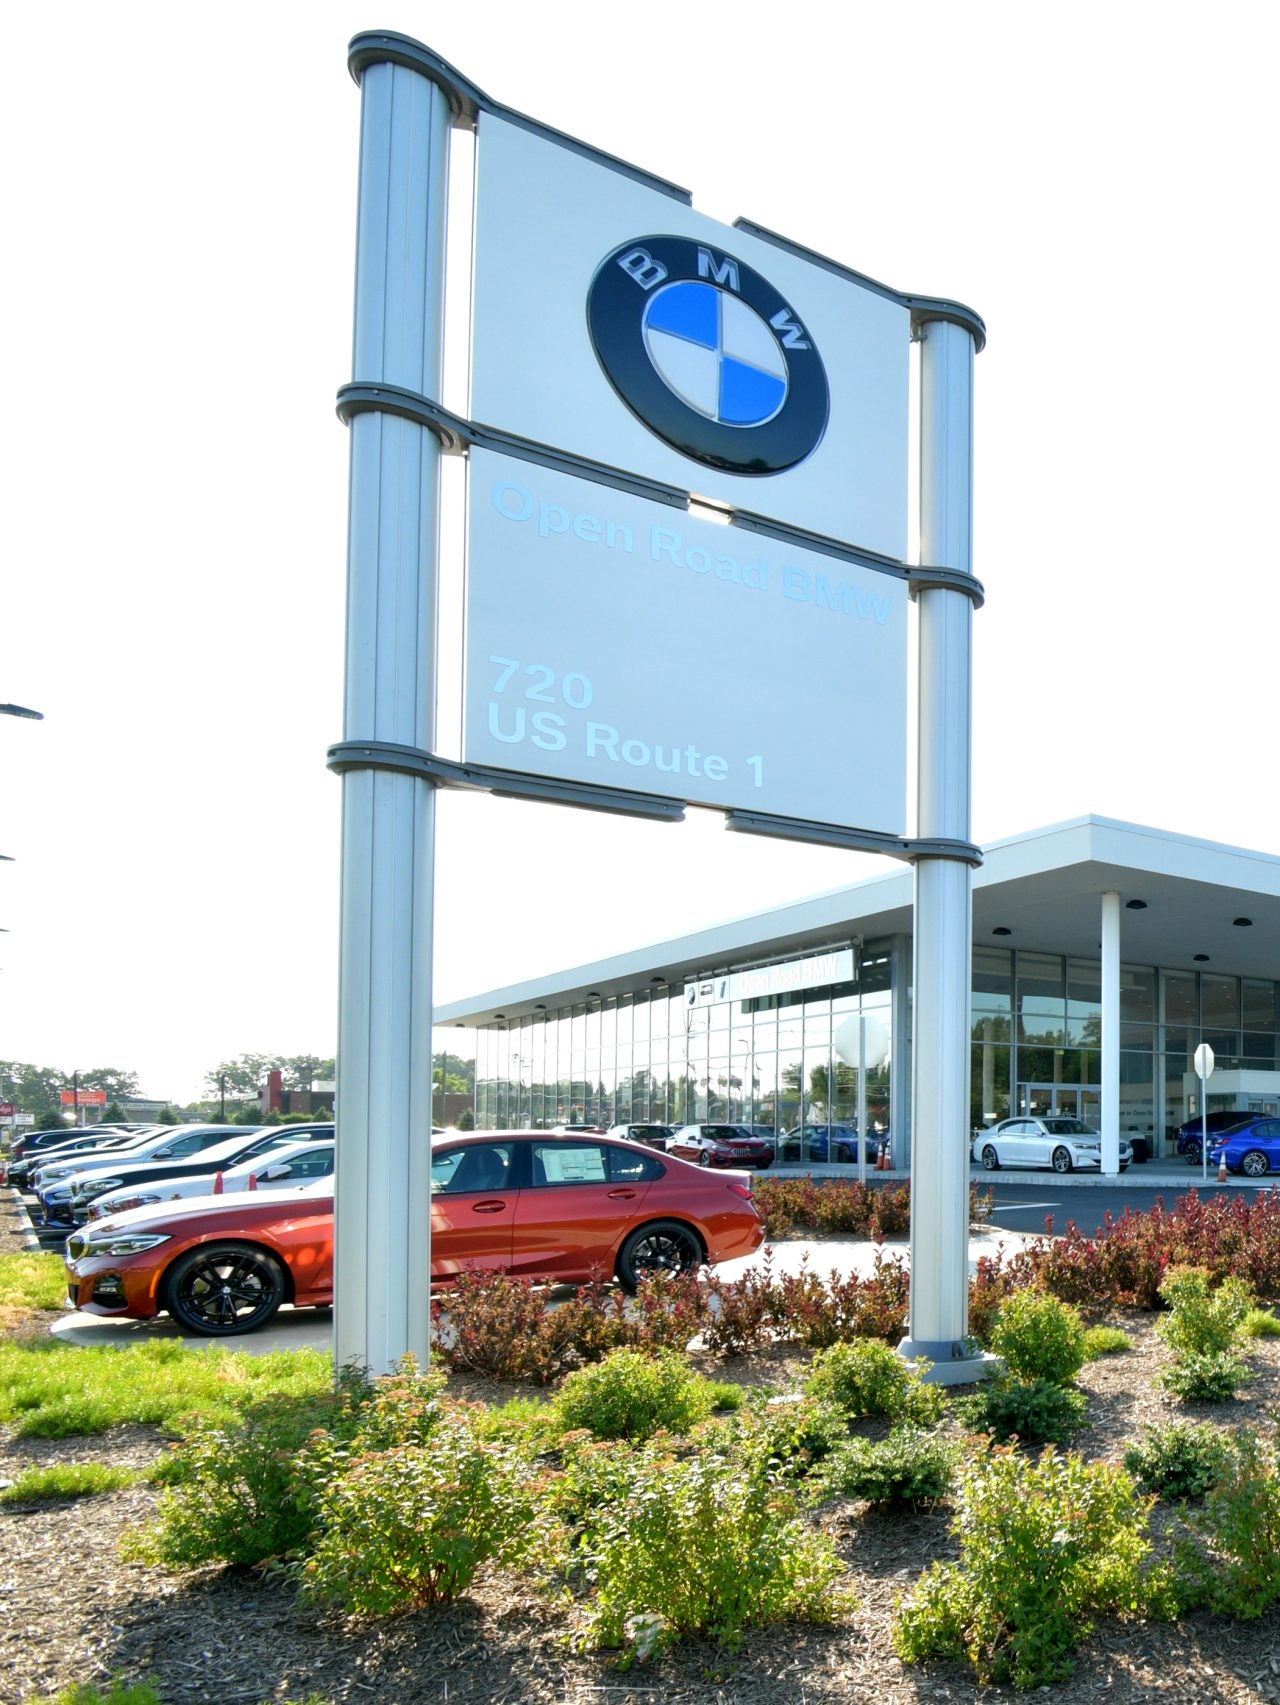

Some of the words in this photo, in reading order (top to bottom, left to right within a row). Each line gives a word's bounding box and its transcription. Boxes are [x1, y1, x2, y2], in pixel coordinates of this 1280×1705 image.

[617, 246, 812, 350] BMW
[490, 479, 634, 553] Open
[650, 524, 768, 591] Road
[782, 564, 894, 625] BMW
[488, 655, 594, 710] 720
[488, 701, 568, 751] US
[585, 720, 729, 781] Route
[745, 754, 764, 788] 1
[742, 973, 768, 993] Open
[772, 964, 800, 988] Road
[804, 955, 837, 980] BMW
